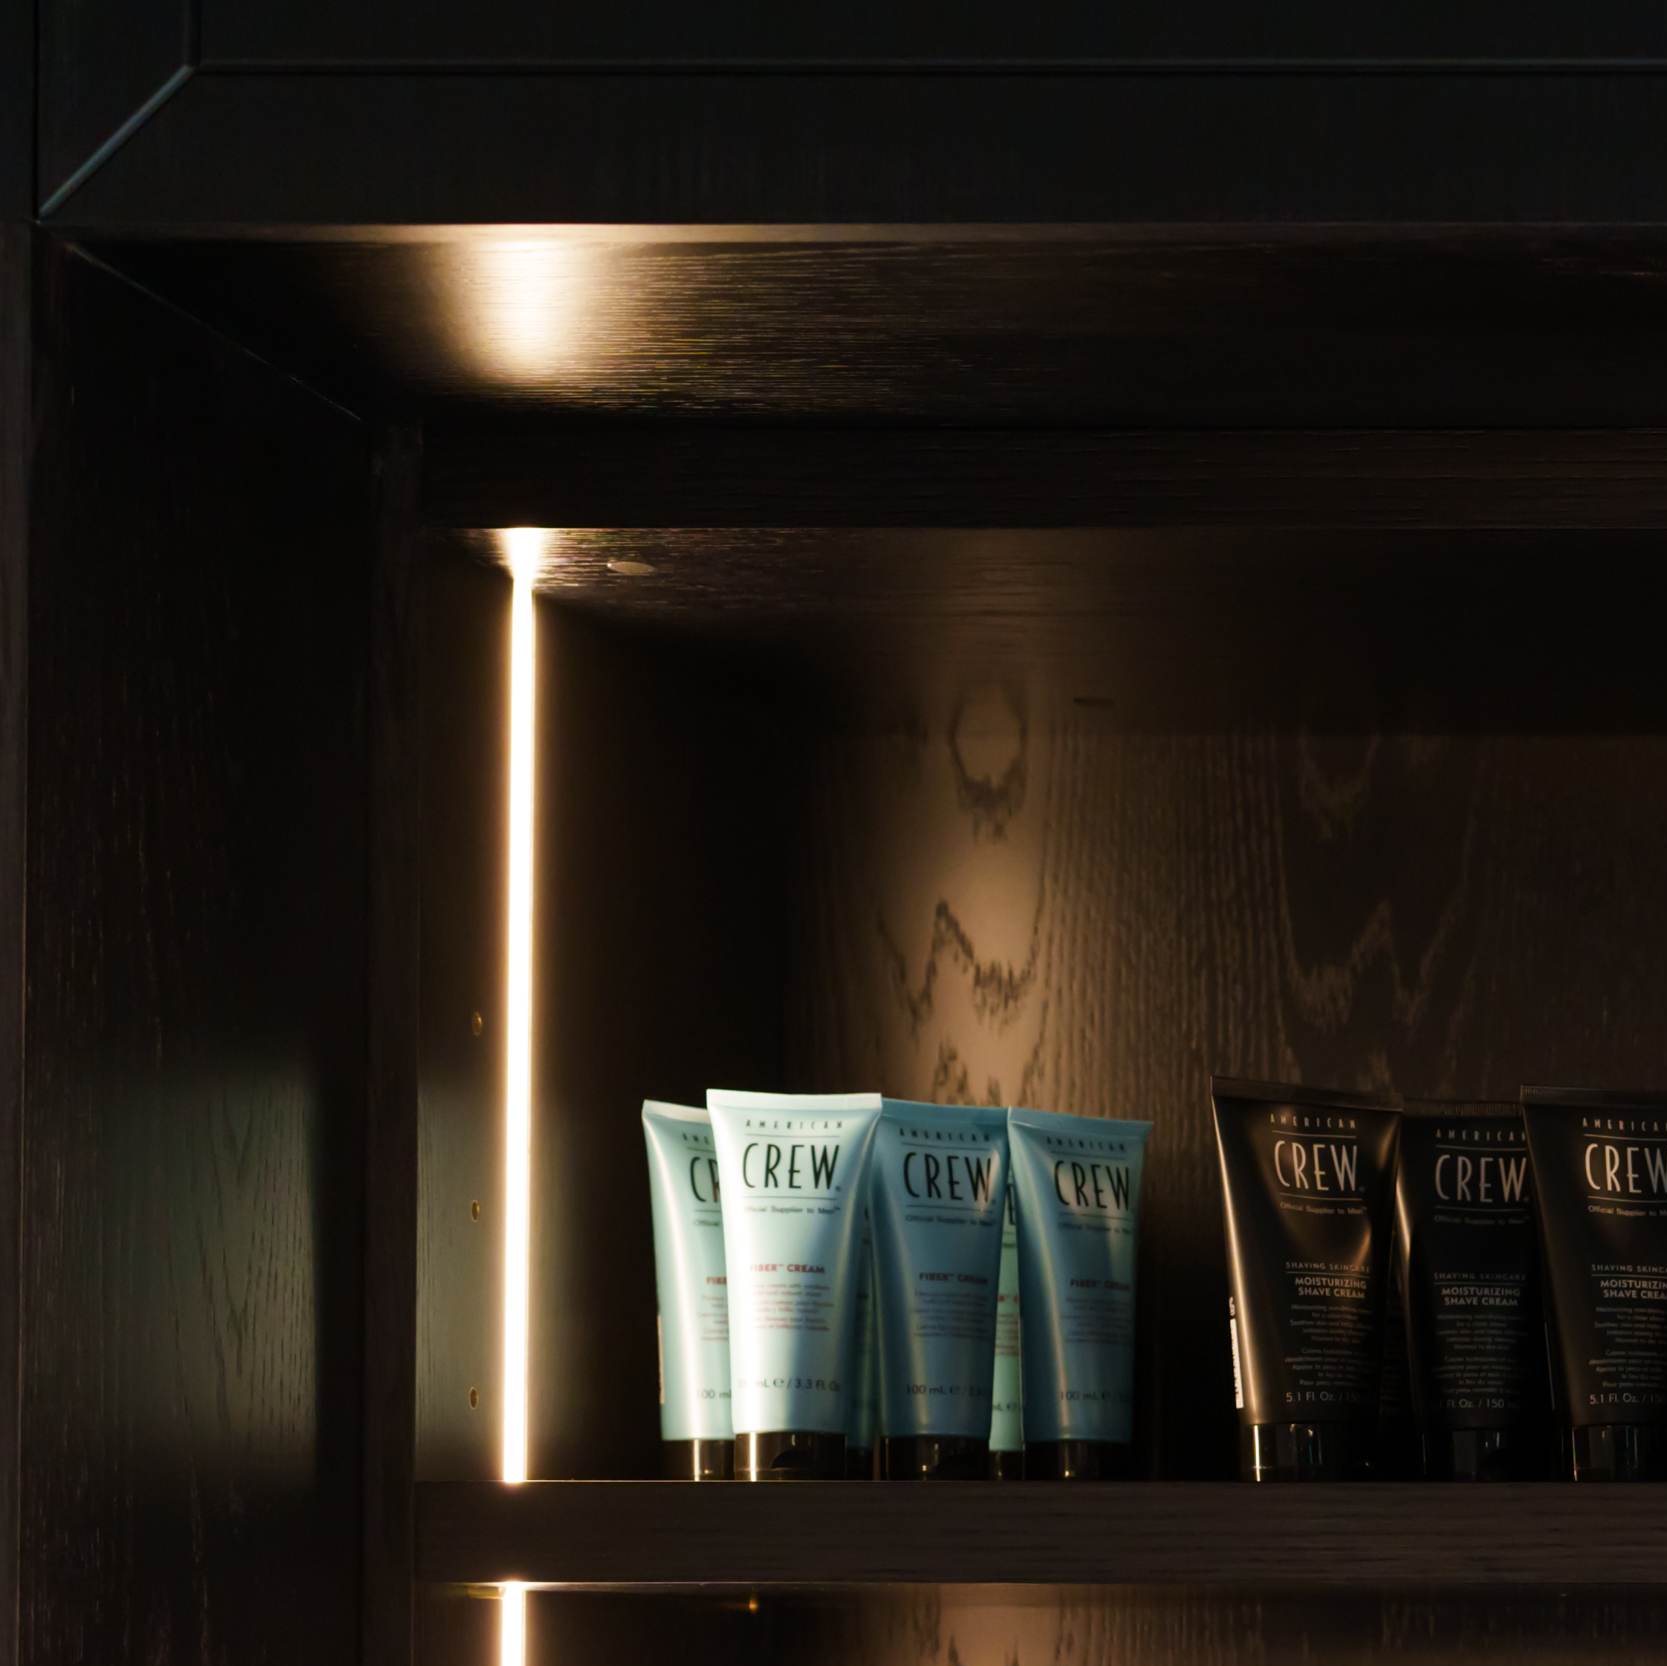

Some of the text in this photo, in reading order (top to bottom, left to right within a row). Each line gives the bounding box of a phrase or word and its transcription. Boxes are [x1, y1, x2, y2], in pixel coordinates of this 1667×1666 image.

[746, 1119, 842, 1129] AMERICAN
[1270, 1113, 1356, 1129] AMERICAN
[900, 1127, 990, 1142] AMERICAN
[742, 1142, 840, 1190] CREW
[1274, 1140, 1358, 1192] CREW
[903, 1152, 992, 1203] CREW
[1054, 1160, 1130, 1211] CREW
[1435, 1154, 1527, 1202] CREW
[787, 1265, 824, 1273] CREAM
[1294, 1277, 1368, 1290] MOISTURIZING
[1298, 1286, 1367, 1299] SHAVE CREAM
